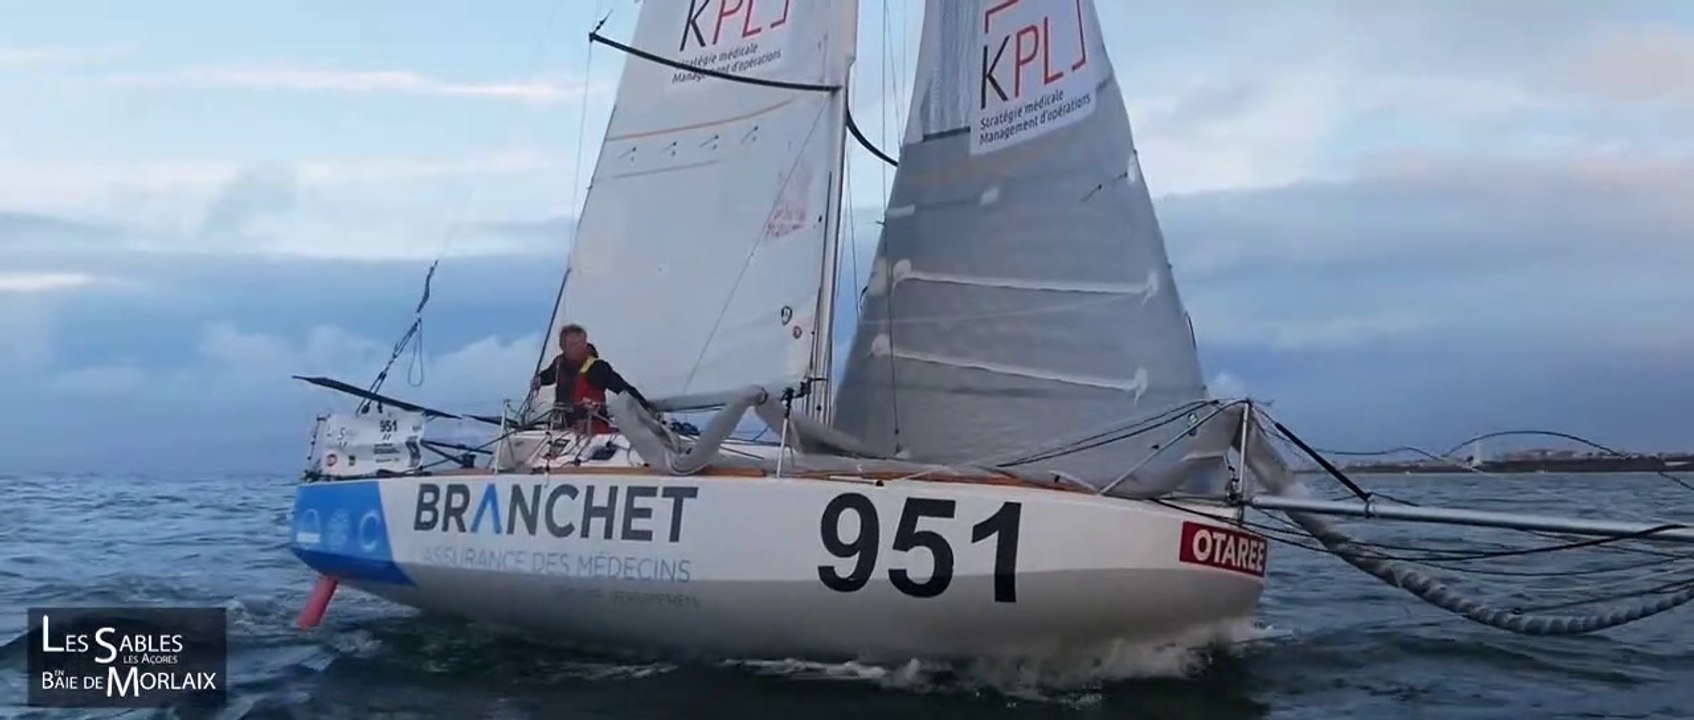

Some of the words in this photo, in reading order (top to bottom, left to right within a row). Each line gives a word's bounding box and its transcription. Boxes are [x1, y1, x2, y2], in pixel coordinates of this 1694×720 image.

[680, 0, 762, 51] KPL
[980, 16, 1064, 109] KPL
[979, 119, 1038, 145] Management
[1039, 93, 1091, 125] d'opérations
[980, 108, 1023, 130] Stratégie
[1024, 89, 1064, 114] médicale
[379, 420, 397, 433] 951
[413, 483, 699, 543] BRANCHET
[532, 552, 568, 575] DES
[817, 492, 1022, 603] 951
[1193, 529, 1265, 572] OTAREE
